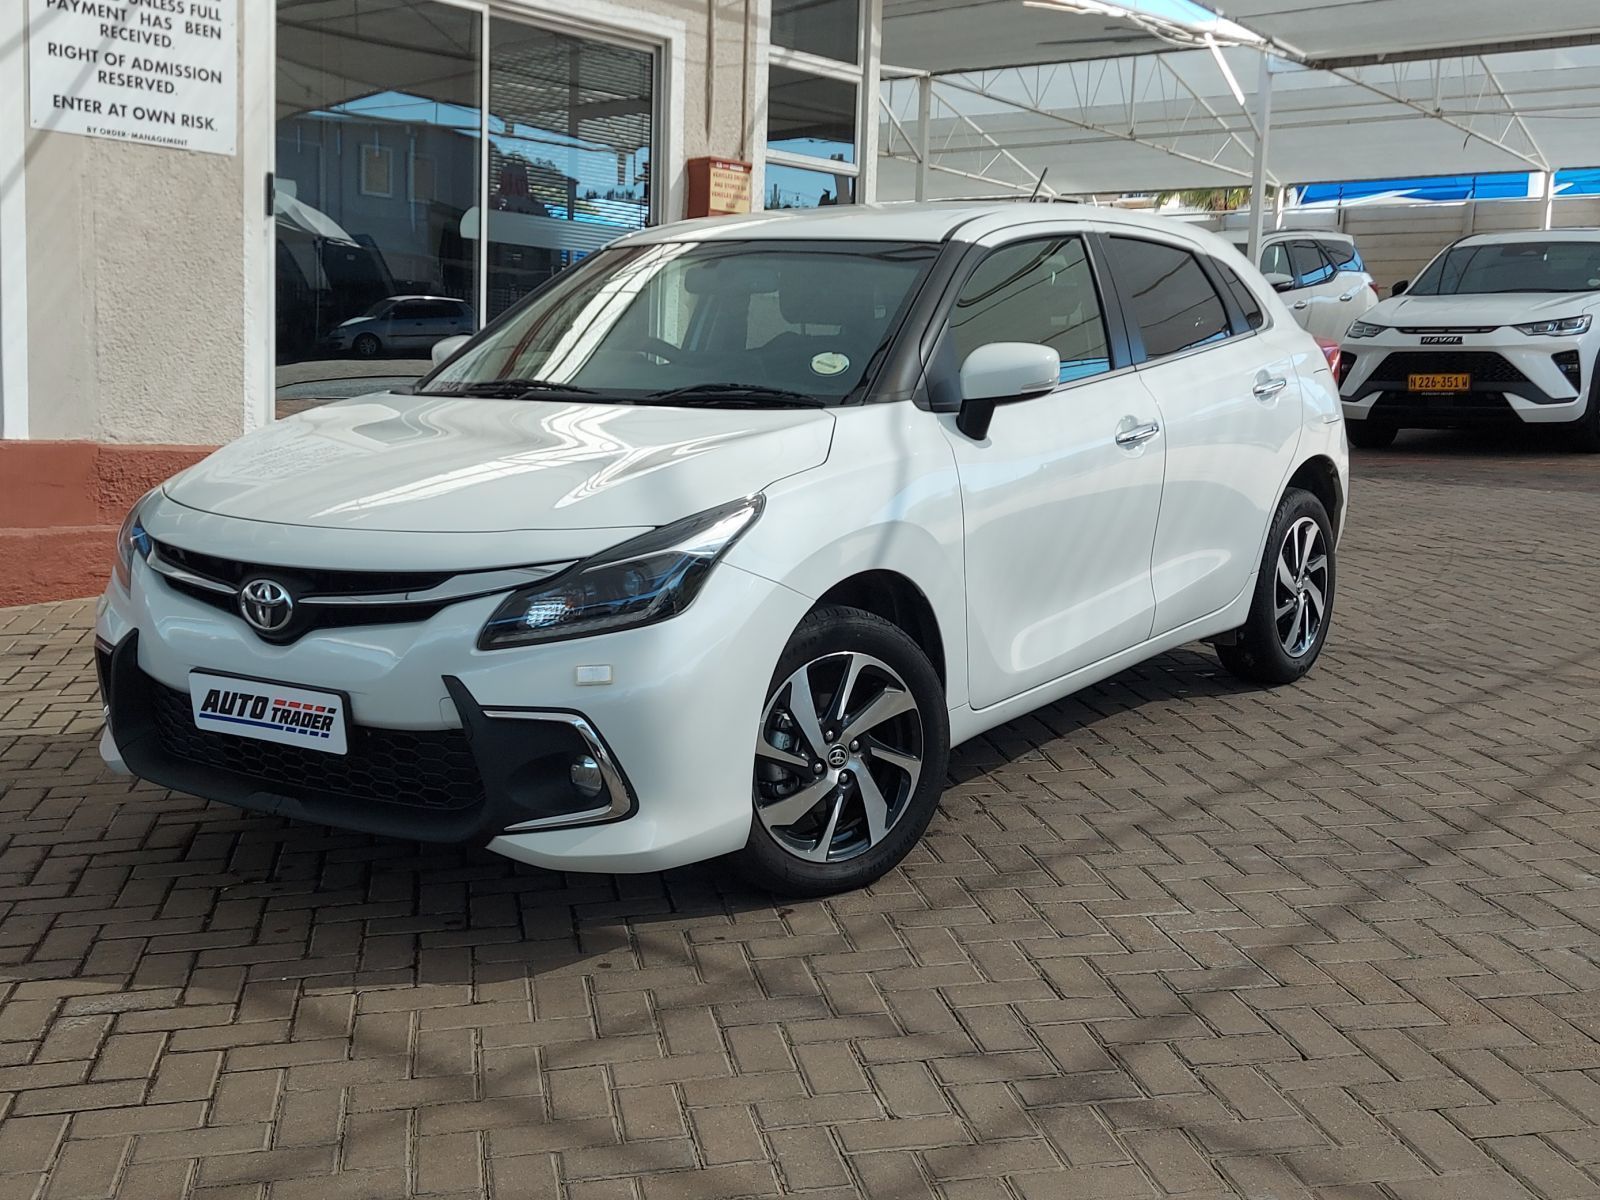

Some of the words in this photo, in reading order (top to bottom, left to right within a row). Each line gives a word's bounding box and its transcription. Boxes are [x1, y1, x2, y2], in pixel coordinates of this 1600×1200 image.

[47, 0, 127, 22] PAYMENT
[140, 12, 172, 30] HAS
[185, 21, 222, 40] BEEN
[190, 4, 222, 21] FULL
[47, 42, 99, 63] RIGHT
[104, 52, 126, 68] OF
[131, 57, 222, 84] ADMISSION
[53, 94, 102, 115] ENTER
[108, 103, 128, 118] AT
[132, 107, 175, 125] OWN
[181, 114, 218, 132] RISK.
[86, 126, 97, 134] BY
[131, 132, 188, 146] MANAGEMENT
[1422, 336, 1462, 344] HAVAL
[1410, 376, 1416, 389] N
[1418, 376, 1459, 388] 226-351
[201, 689, 269, 719] AUTO
[270, 707, 334, 732] TRADER
